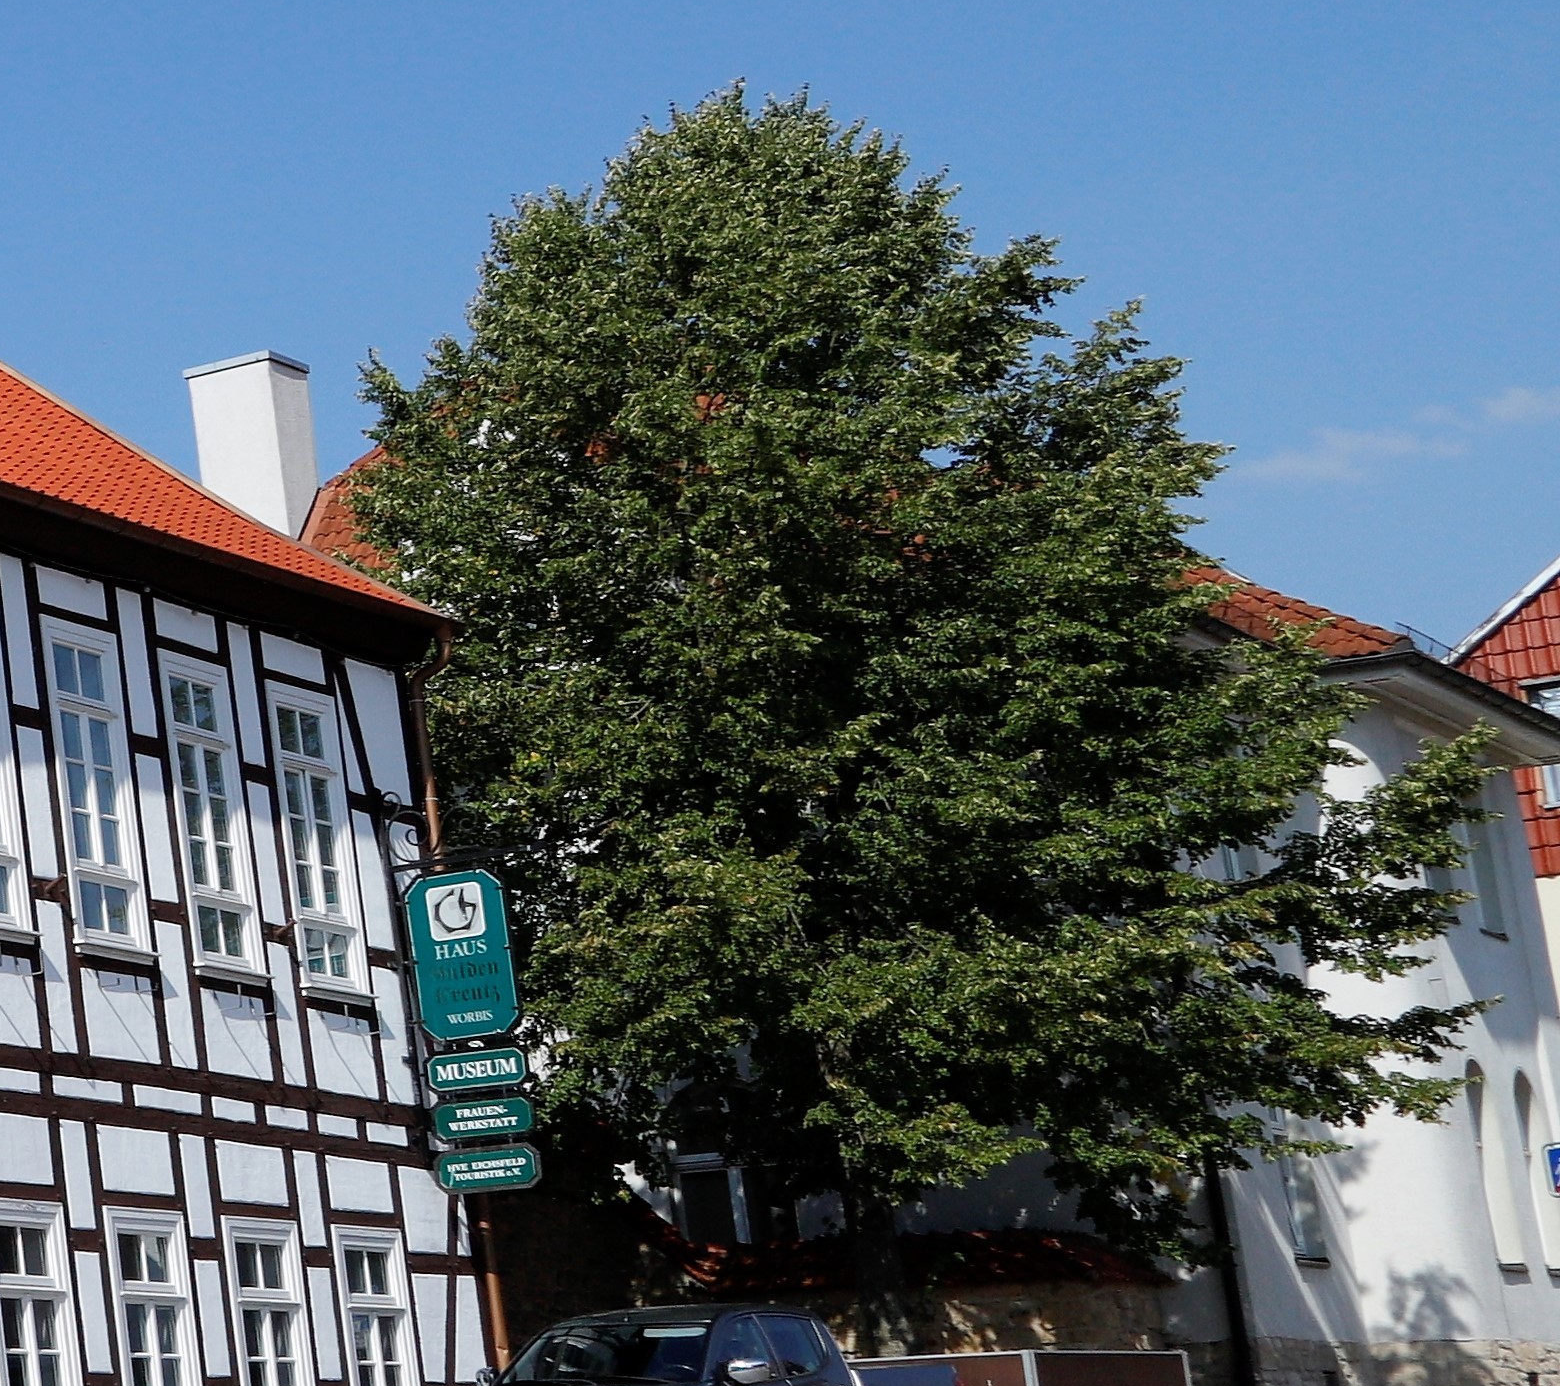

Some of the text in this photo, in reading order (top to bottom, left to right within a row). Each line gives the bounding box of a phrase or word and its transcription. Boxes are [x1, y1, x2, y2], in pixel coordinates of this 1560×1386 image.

[435, 940, 487, 960] HAUS
[448, 1010, 493, 1024] WORBIS
[436, 1058, 518, 1081] MUSEUM
[456, 1105, 508, 1118] FRAUEN-
[449, 1117, 518, 1131] WERKSTATT
[472, 1158, 526, 1169] EICHSFELD
[455, 1170, 505, 1181] TOURISTIK
